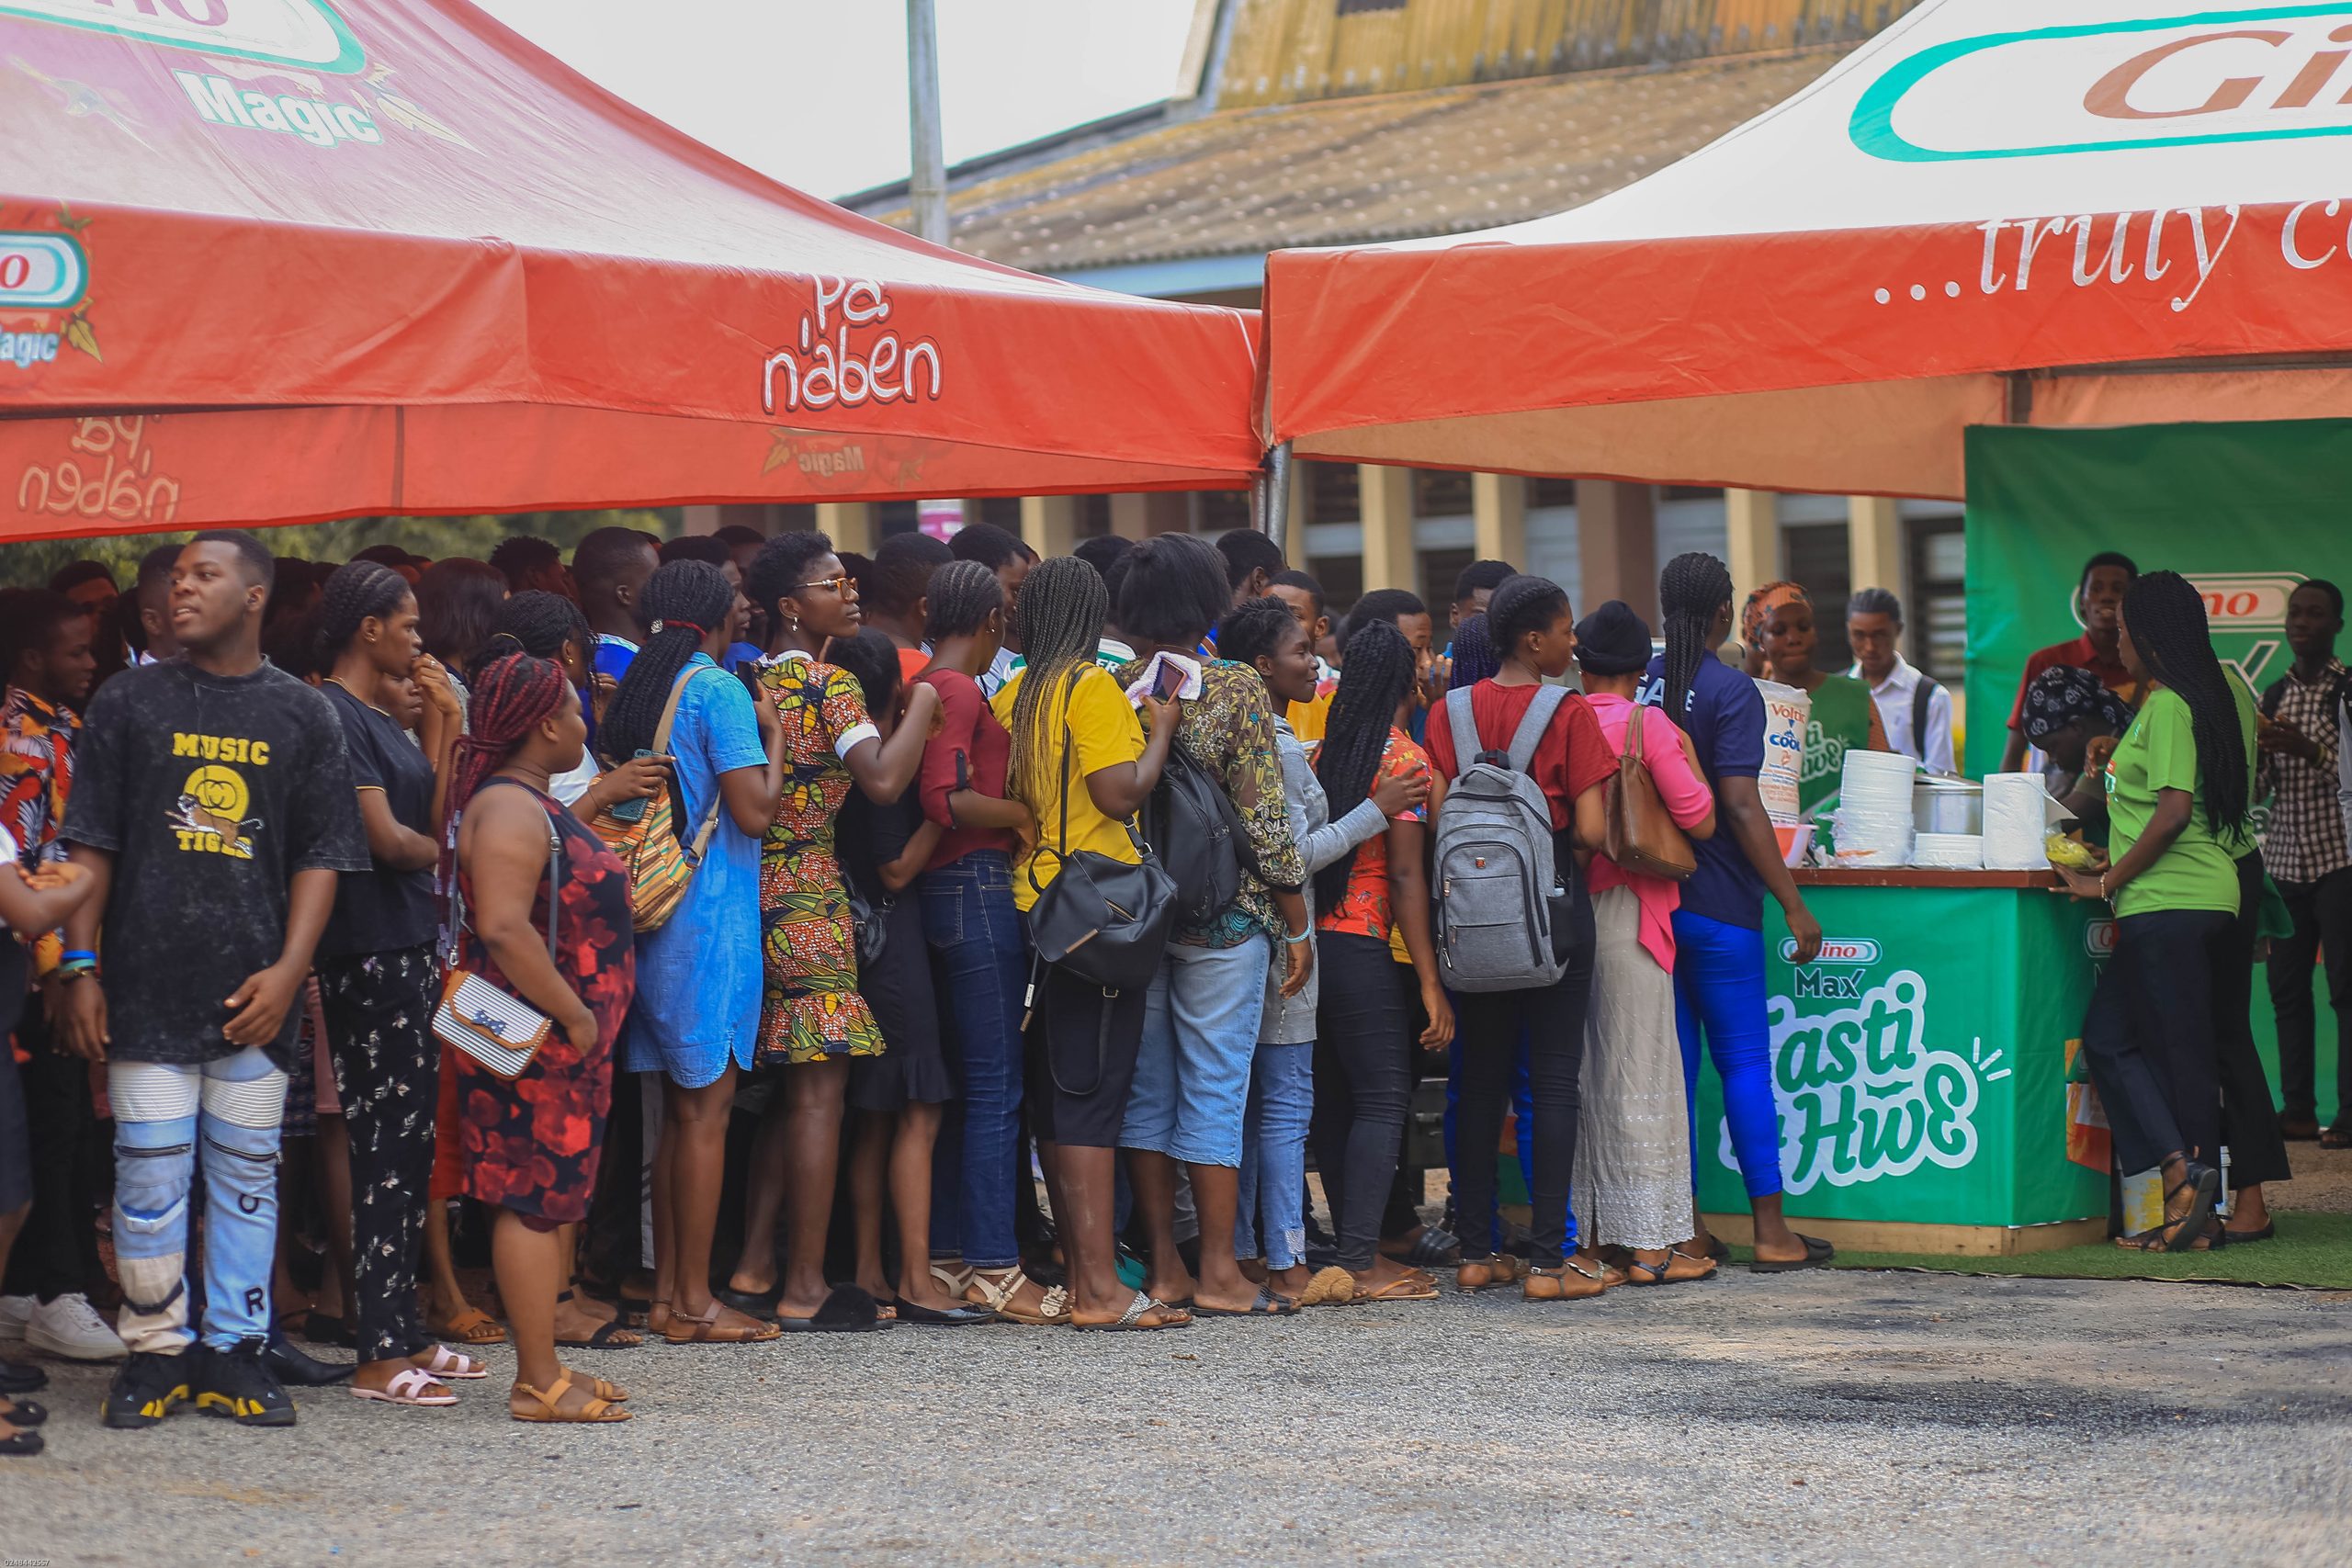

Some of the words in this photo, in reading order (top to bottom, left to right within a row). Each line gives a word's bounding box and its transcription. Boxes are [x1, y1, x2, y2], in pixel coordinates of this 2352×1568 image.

[174, 70, 382, 148] Magic
[0, 333, 59, 368] agic
[2200, 592, 2259, 617] no
[172, 732, 270, 766] MUSIC
[175, 830, 254, 860] TIG
[1822, 942, 1858, 958] ino
[1769, 981, 1917, 1093] asti
[244, 1287, 265, 1318] R
